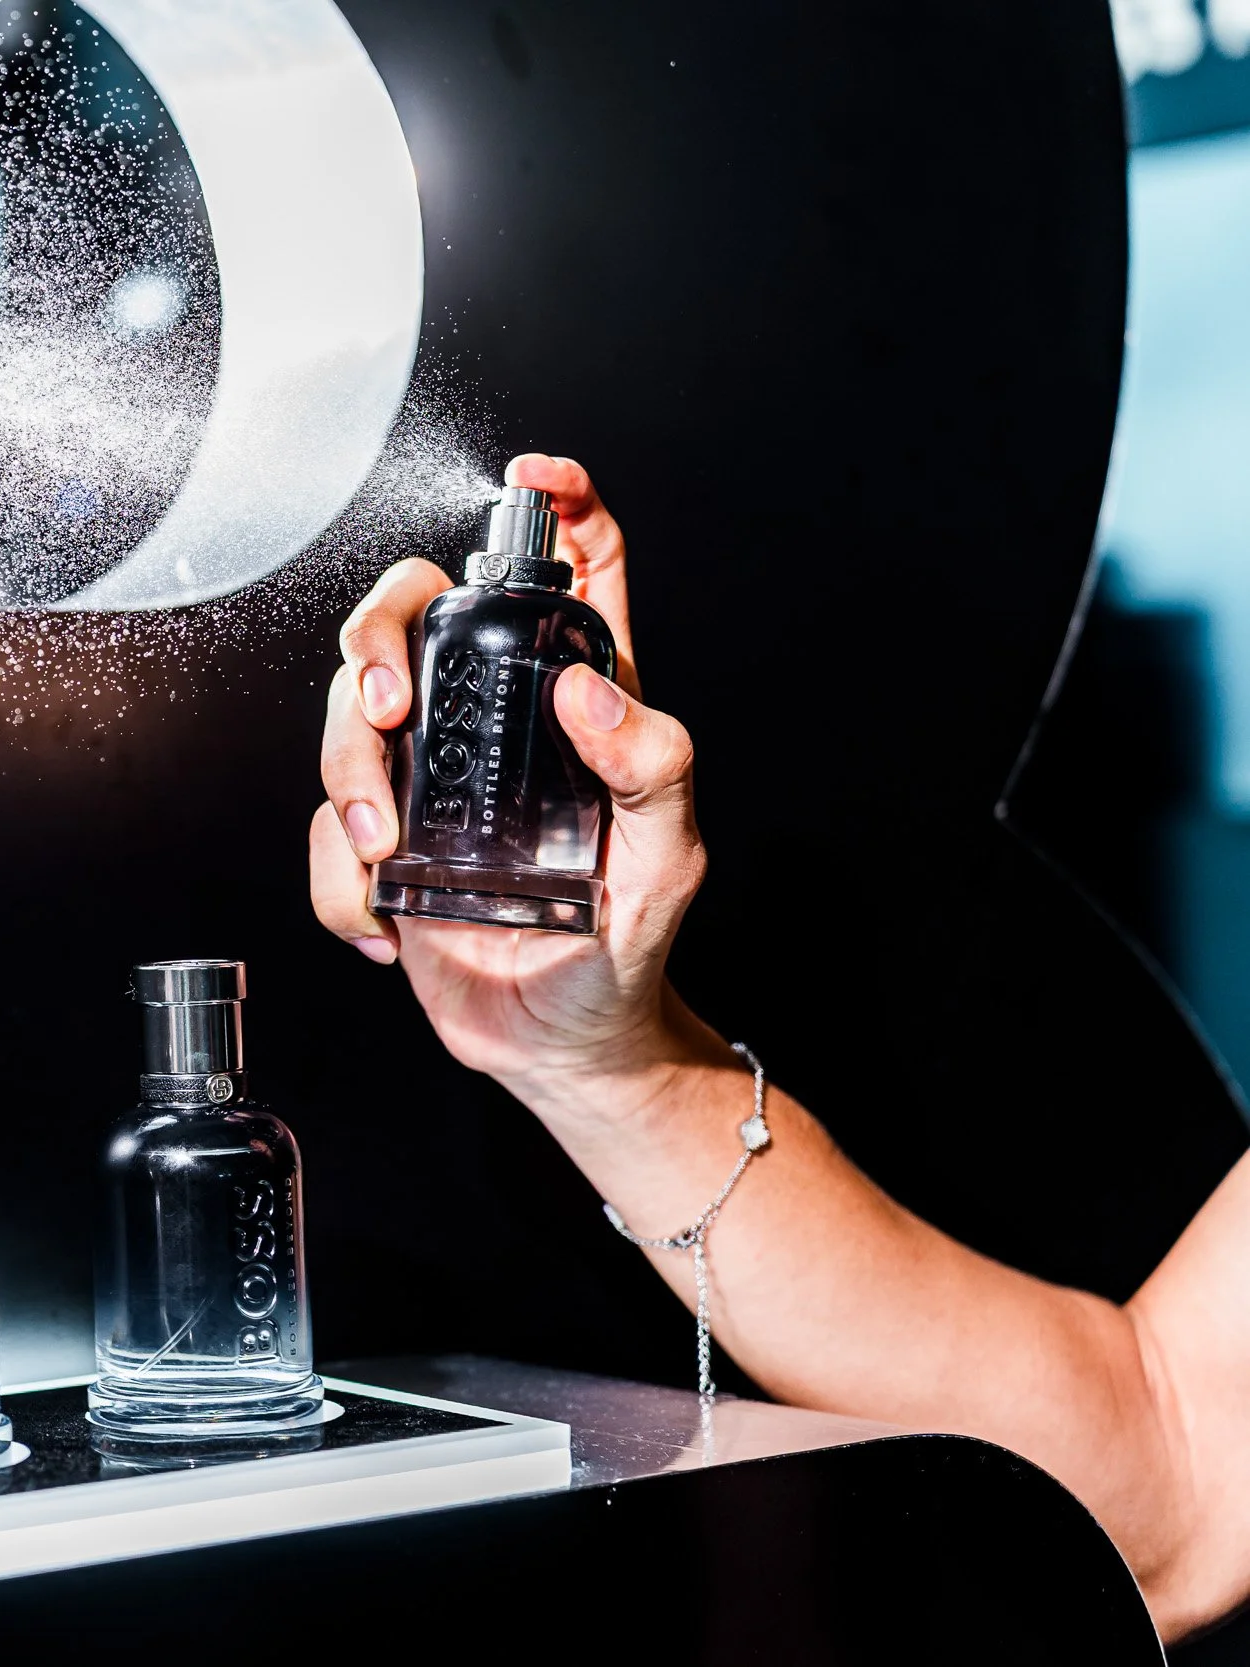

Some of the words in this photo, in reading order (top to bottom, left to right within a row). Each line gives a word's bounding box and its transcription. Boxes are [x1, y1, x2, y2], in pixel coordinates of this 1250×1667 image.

[422, 649, 487, 832] BOSS
[481, 745, 502, 834] BOTTLED
[492, 655, 511, 734] BEYOND
[234, 1179, 281, 1367] BOSS
[284, 1177, 295, 1256] BEYOND
[287, 1267, 298, 1357] BOTTLED
